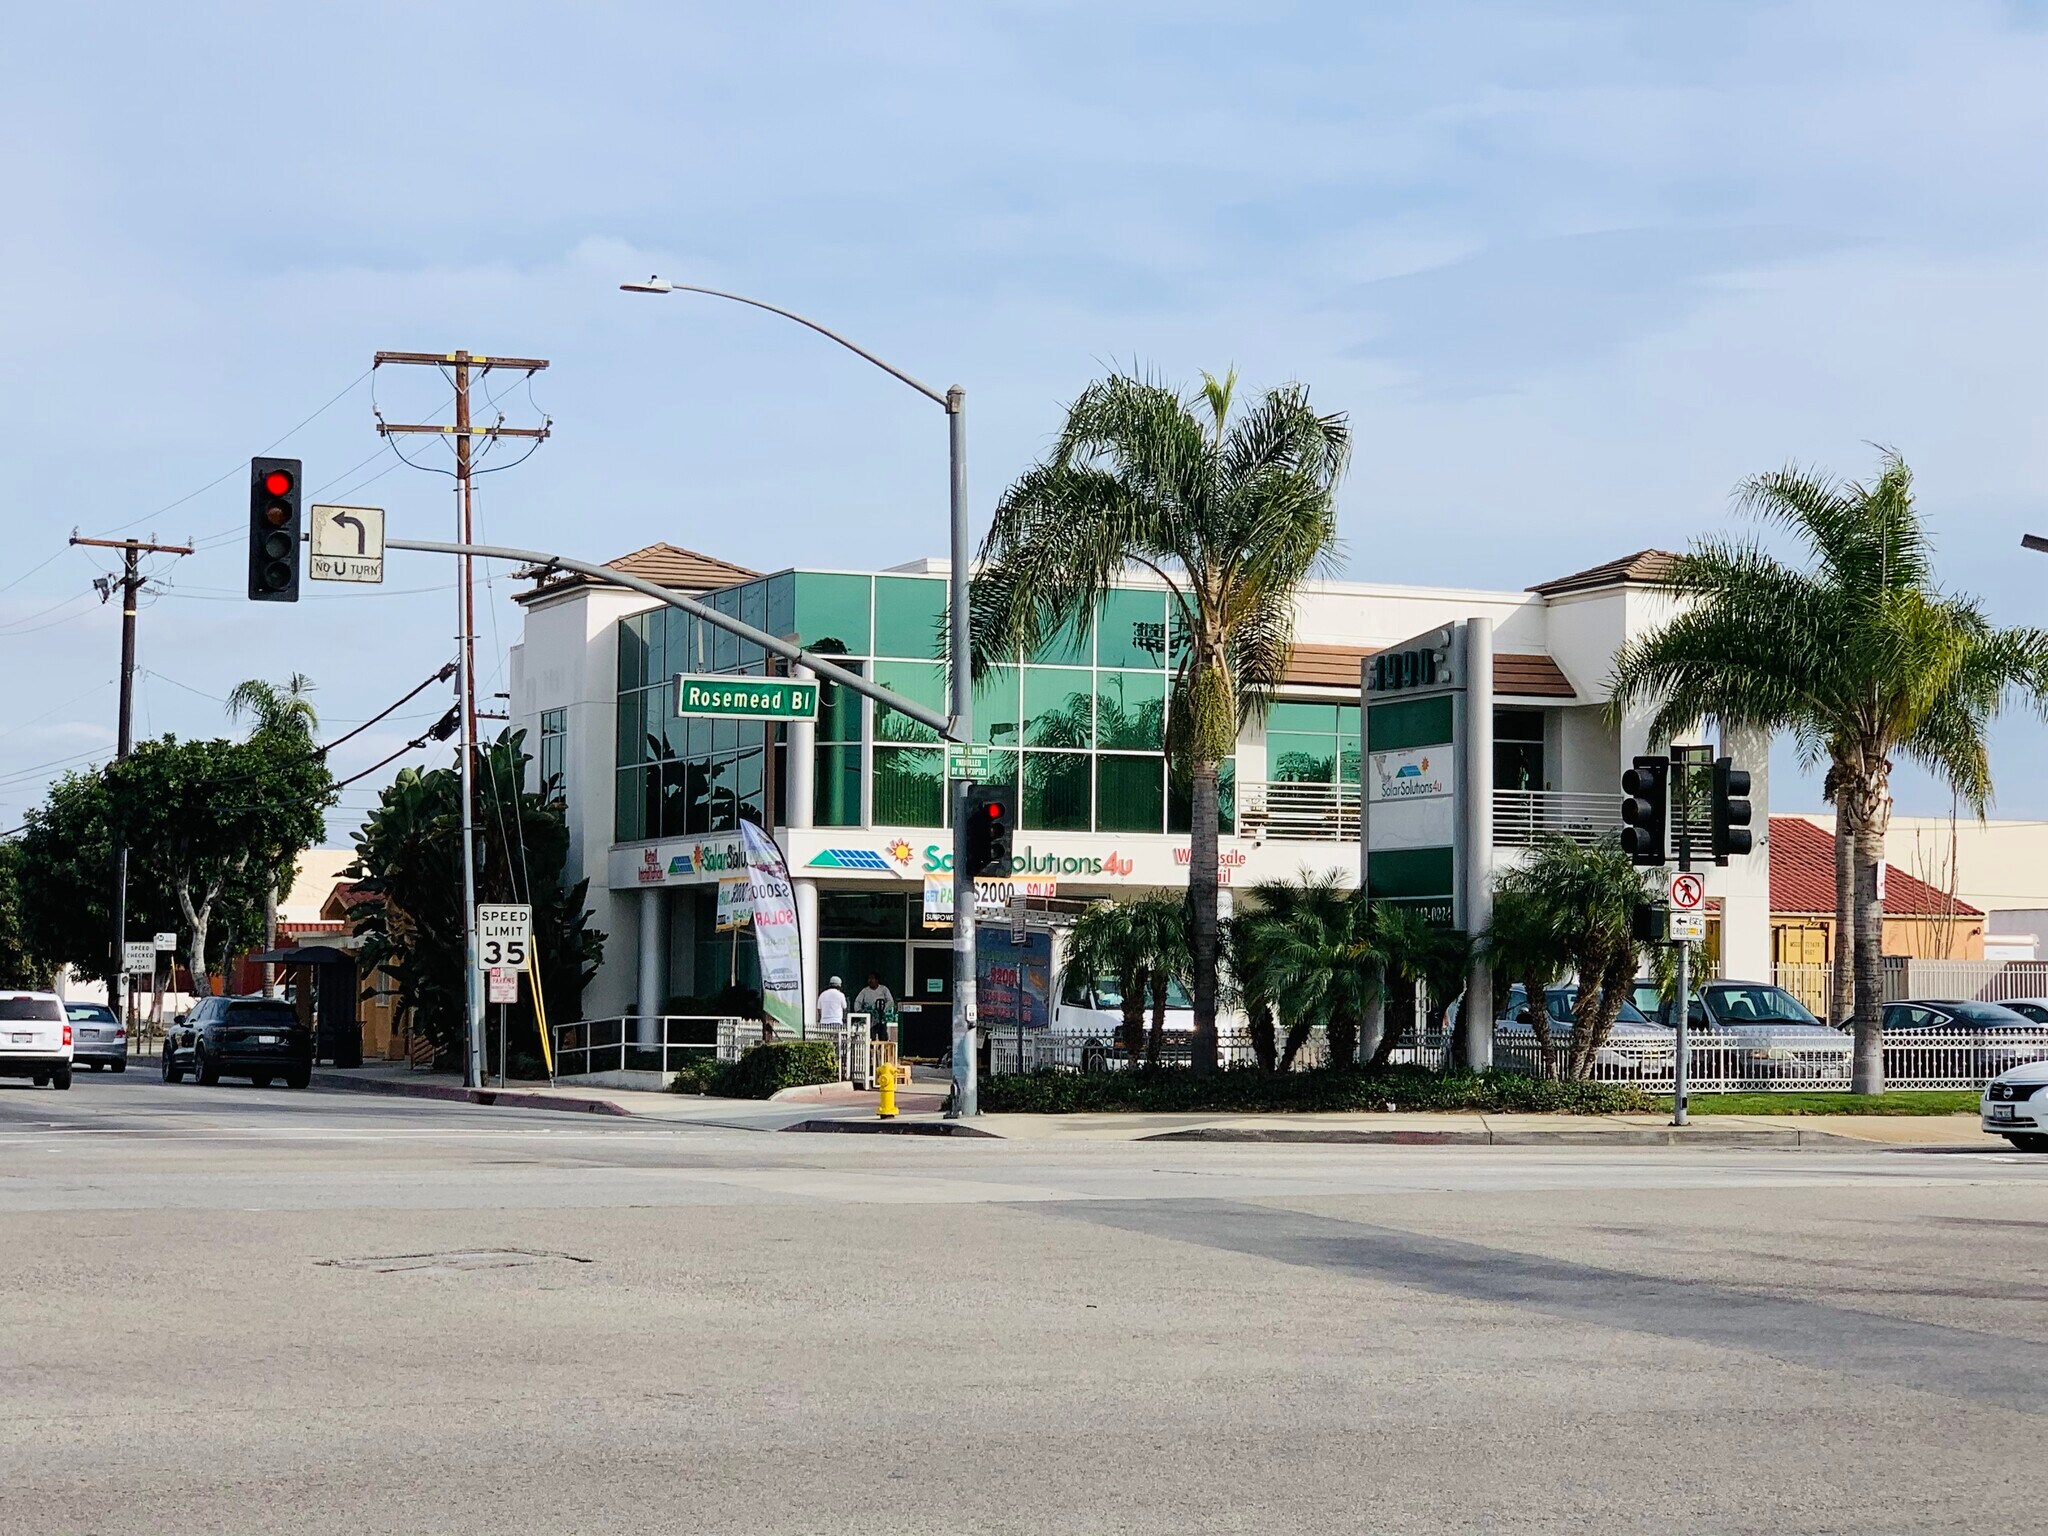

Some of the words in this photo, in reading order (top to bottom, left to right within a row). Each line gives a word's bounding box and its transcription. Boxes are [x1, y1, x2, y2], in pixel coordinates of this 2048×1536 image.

[315, 562, 331, 573] NO
[334, 562, 346, 576] U
[350, 564, 378, 576] TURN
[689, 686, 782, 709] Rosemead
[792, 691, 810, 710] Bl
[1381, 779, 1442, 797] SolarSolutions4u
[701, 841, 747, 871] SolarSolu
[923, 845, 1134, 876] Soolutions4u
[1176, 848, 1247, 865] Wsale
[925, 890, 939, 902] GET
[482, 911, 528, 921] SPEED
[486, 926, 523, 936] LIMIT
[1672, 927, 1703, 936] CROSSLK
[484, 941, 525, 965] 35
